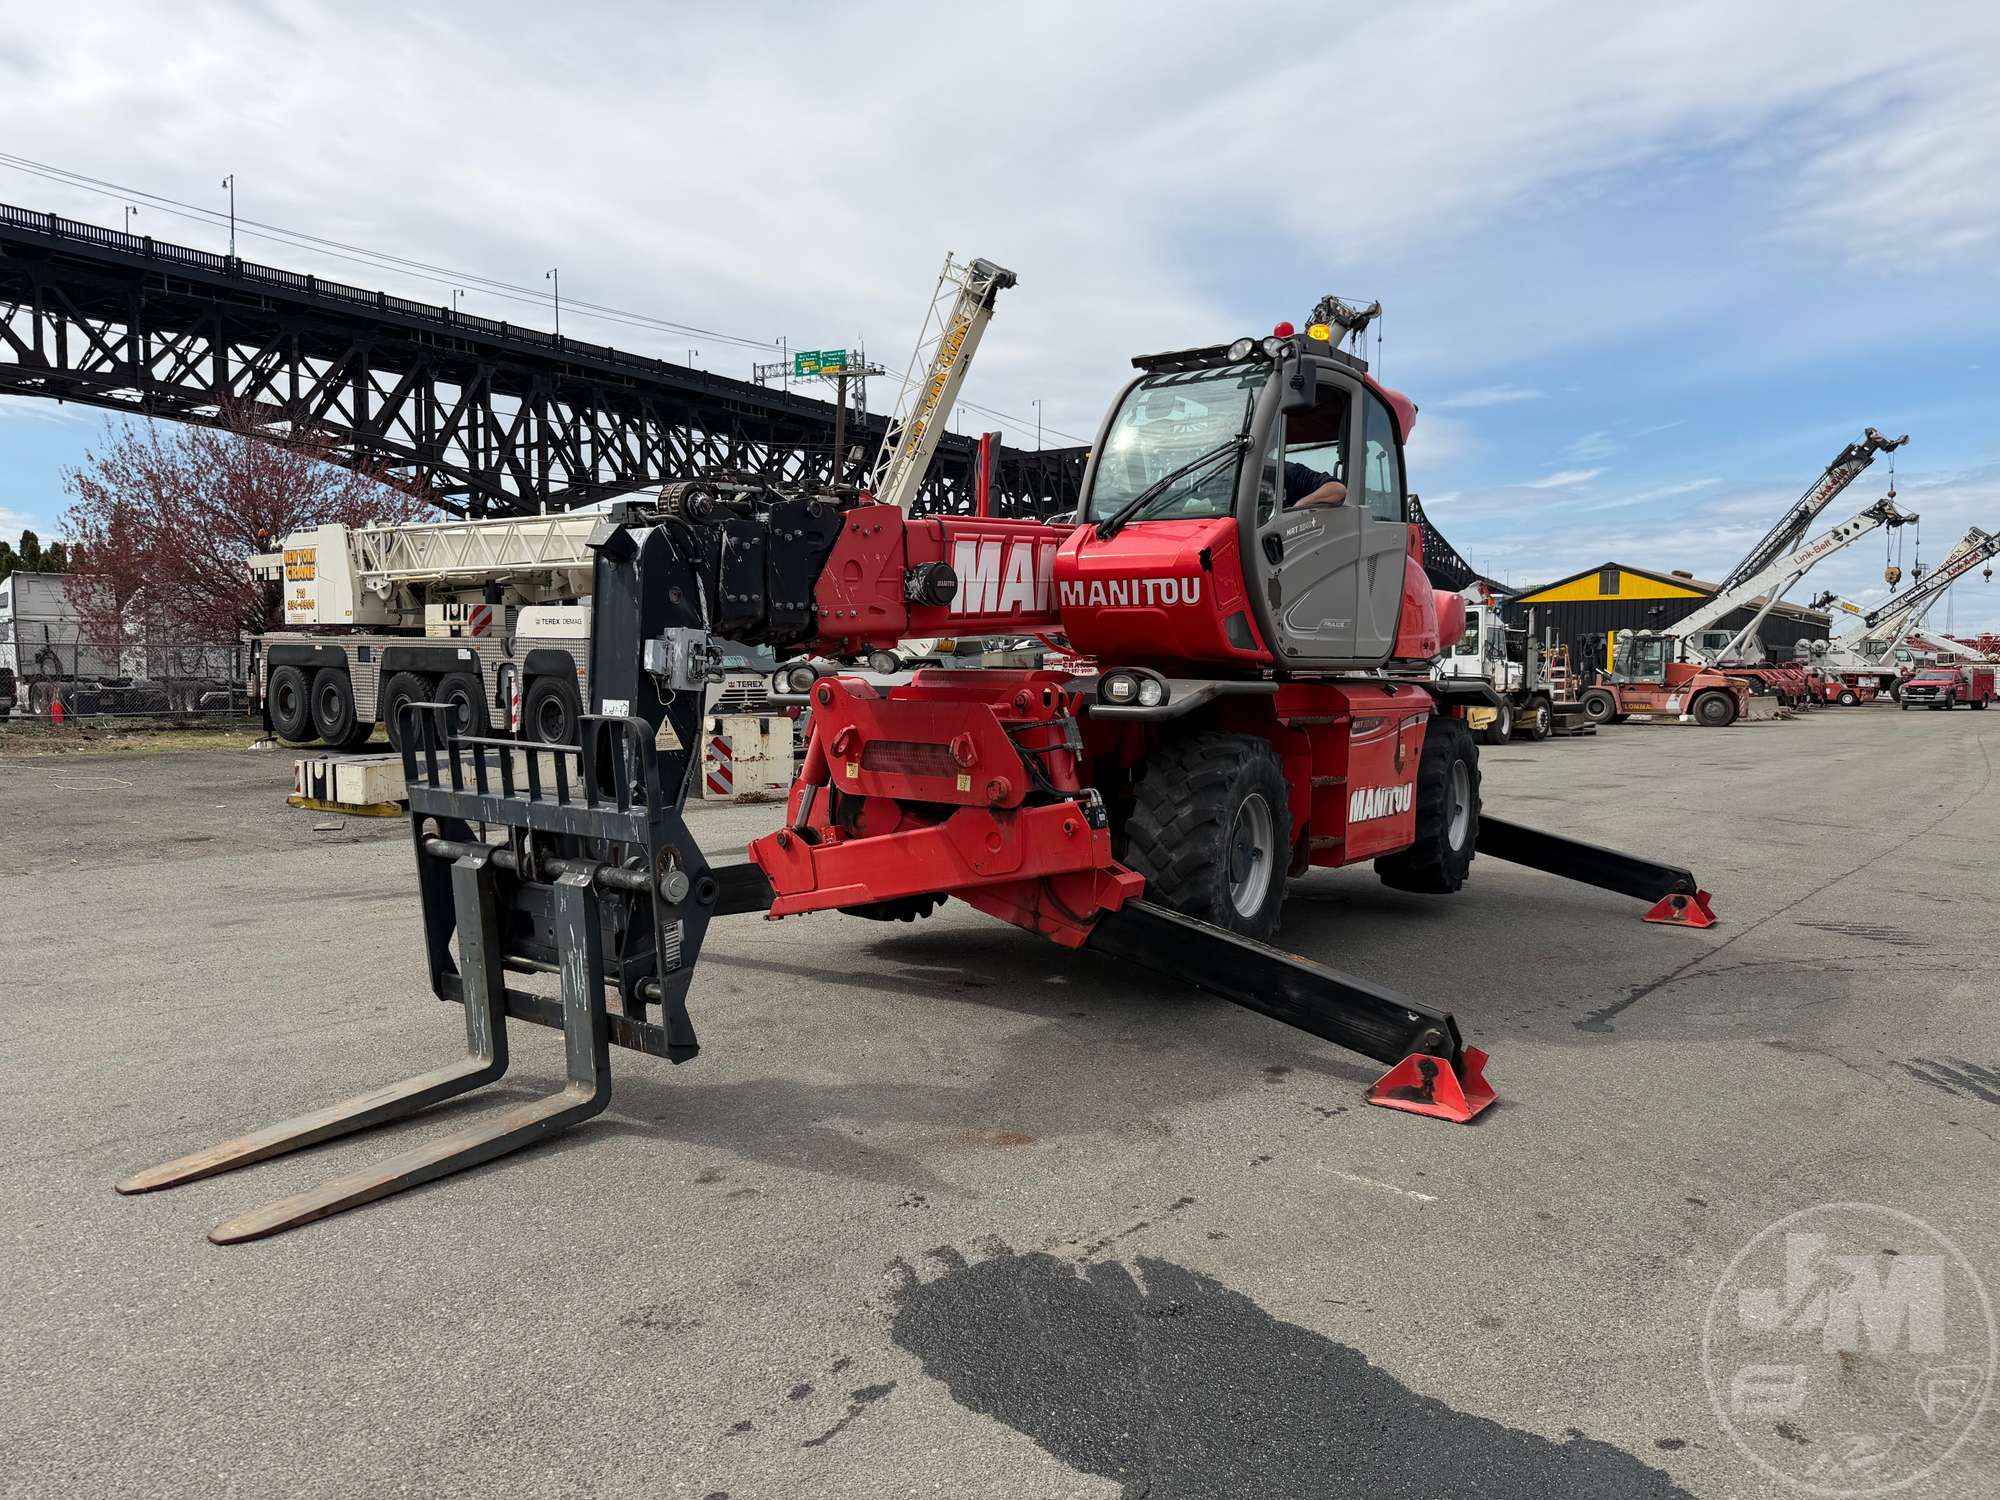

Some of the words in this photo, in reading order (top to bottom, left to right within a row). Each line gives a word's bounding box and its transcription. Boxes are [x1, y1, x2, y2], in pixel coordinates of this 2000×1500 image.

[284, 549, 299, 566] NEW
[297, 548, 316, 565] YORK
[1793, 539, 1832, 565] Link-Belt
[286, 564, 315, 582] CRANE
[1059, 577, 1200, 607] MANITOU
[736, 680, 764, 688] TEREX
[1349, 782, 1413, 824] MANITOU
